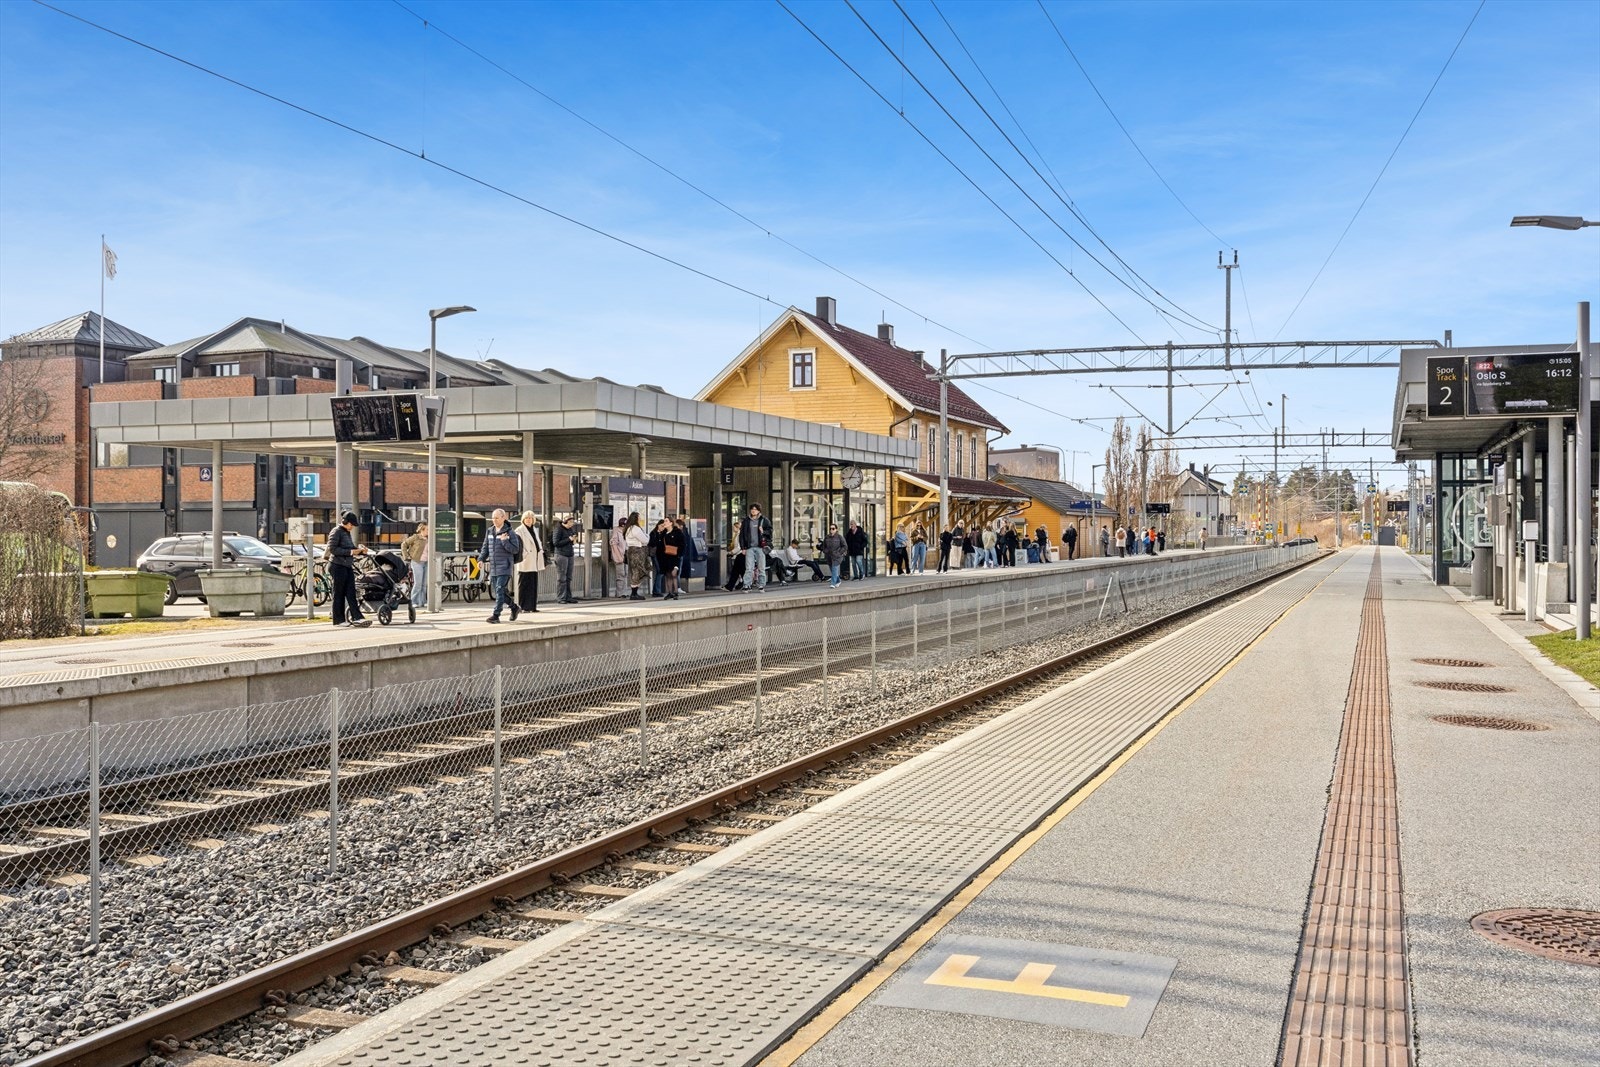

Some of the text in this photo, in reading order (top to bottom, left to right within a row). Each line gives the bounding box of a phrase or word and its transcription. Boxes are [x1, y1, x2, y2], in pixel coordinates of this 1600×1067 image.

[1436, 366, 1454, 375] Spor
[1476, 371, 1506, 380] Oslo S
[1545, 368, 1572, 378] 16:12
[1437, 373, 1457, 381] Track
[1439, 386, 1453, 405] 2
[405, 417, 412, 432] 1
[303, 475, 311, 488] P
[725, 474, 731, 483] E
[923, 953, 1131, 1008] F
